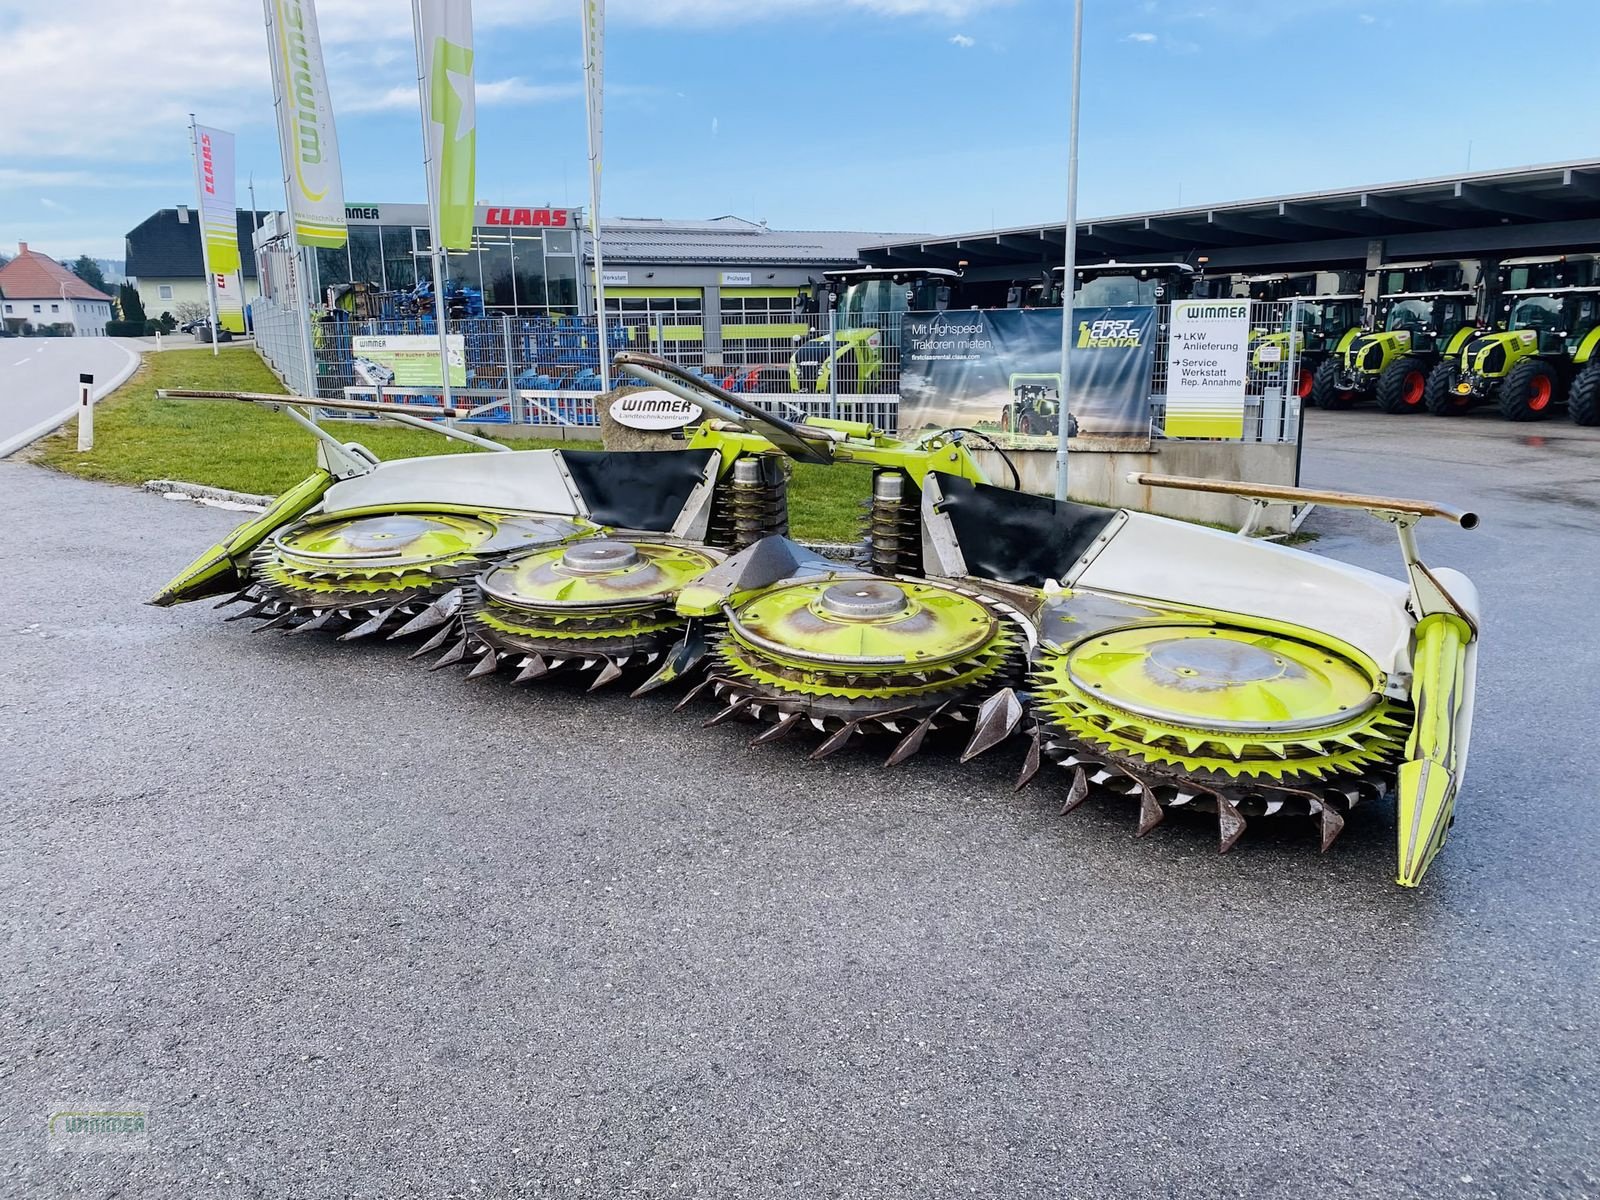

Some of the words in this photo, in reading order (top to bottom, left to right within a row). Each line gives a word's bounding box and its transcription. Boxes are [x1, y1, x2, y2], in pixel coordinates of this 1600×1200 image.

[284, 0, 321, 164] WIMME
[202, 133, 214, 195] CLAAS
[345, 208, 380, 219] MMER
[486, 208, 567, 226] CLAAS
[1187, 307, 1247, 318] WIMMER
[912, 324, 927, 335] Mit
[929, 323, 983, 336] Highspeed
[1091, 320, 1135, 330] FIRST
[1090, 329, 1140, 338] CLAAS
[360, 340, 387, 348] WIMMER
[911, 339, 955, 350] Traktoren
[957, 339, 994, 349] mieten.
[1087, 338, 1142, 348] RENTAL
[1183, 342, 1239, 352] Anlieferung
[1182, 358, 1218, 367] Service
[1181, 368, 1227, 377] Werkstatt
[1181, 378, 1200, 388] Rep.
[1201, 378, 1242, 387] Annahme
[622, 400, 692, 412] WIMMER
[619, 413, 689, 421] Landtechnikzentrum
